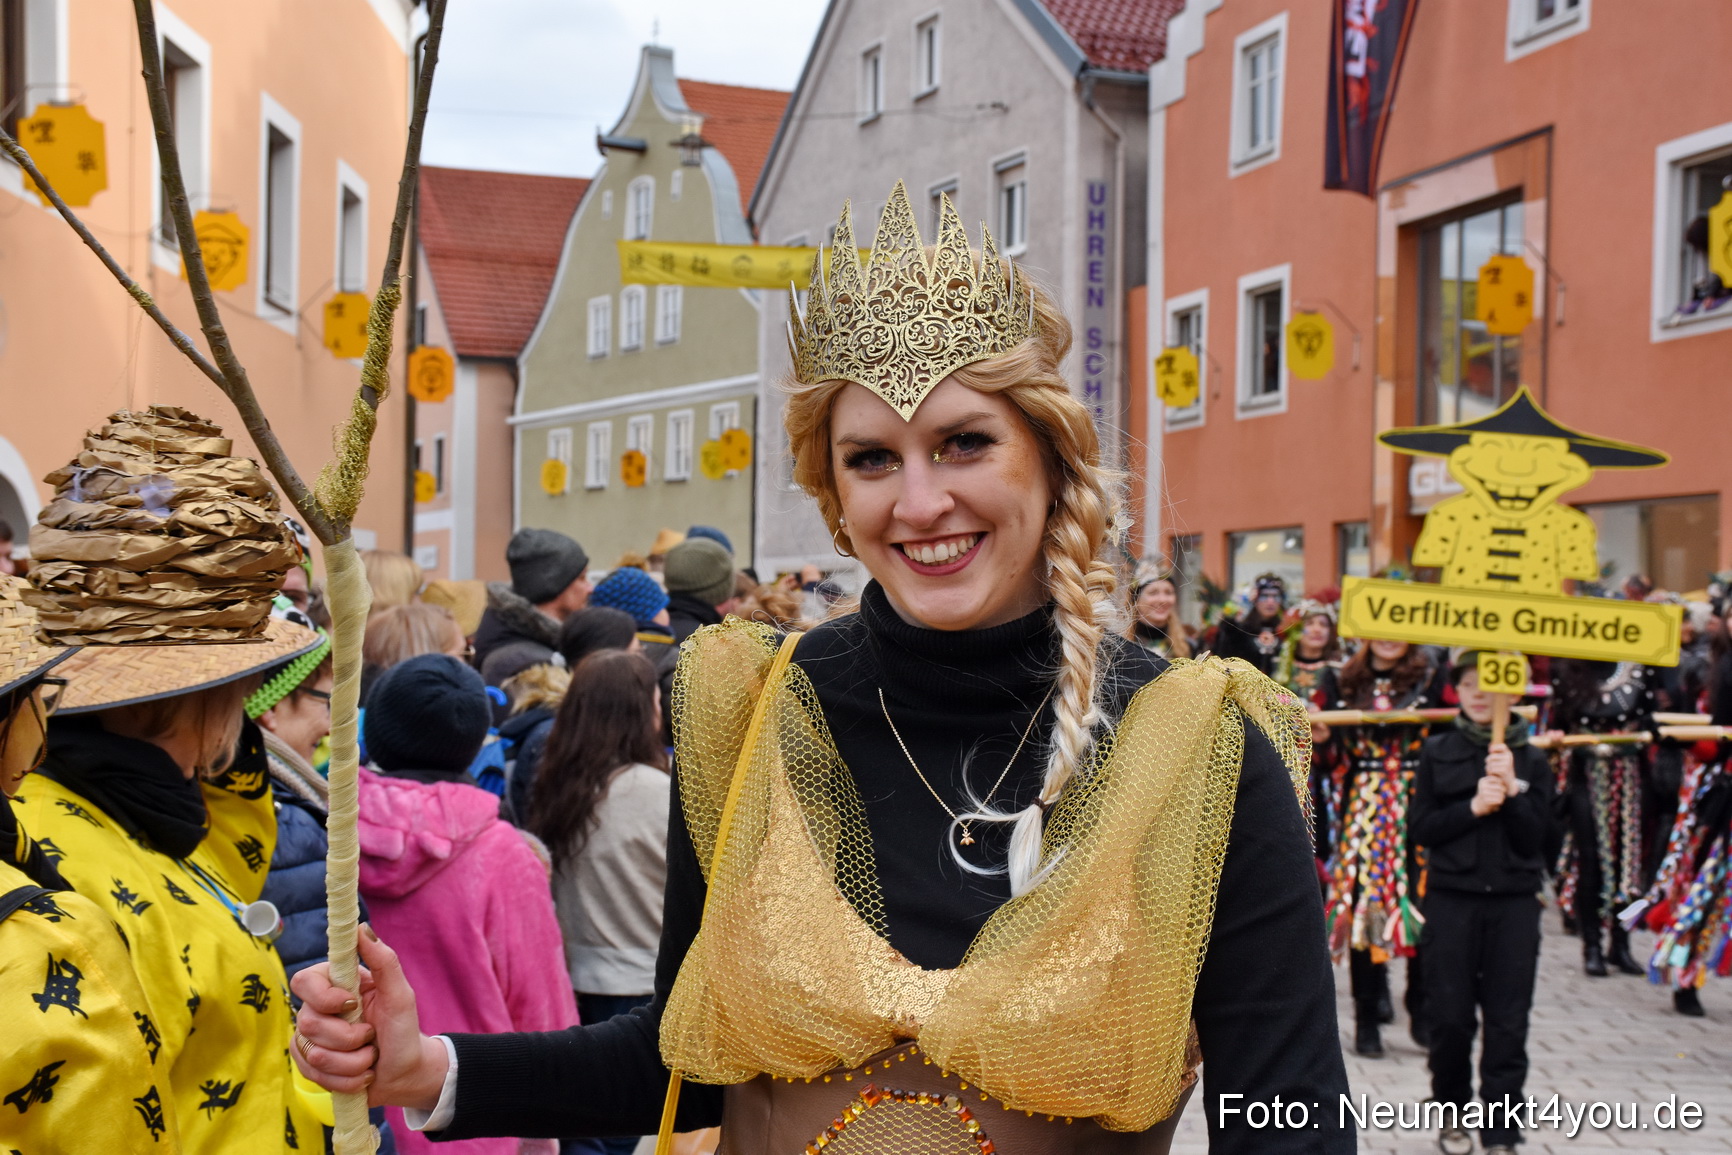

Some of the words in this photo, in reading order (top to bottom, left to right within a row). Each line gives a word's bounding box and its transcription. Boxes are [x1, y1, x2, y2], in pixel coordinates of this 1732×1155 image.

[1087, 181, 1106, 307] UHREN
[1085, 326, 1103, 416] SCH
[1409, 462, 1465, 496] GL
[1367, 596, 1501, 631] Verflixte
[1512, 608, 1642, 644] Gmixde
[1483, 659, 1522, 686] 36
